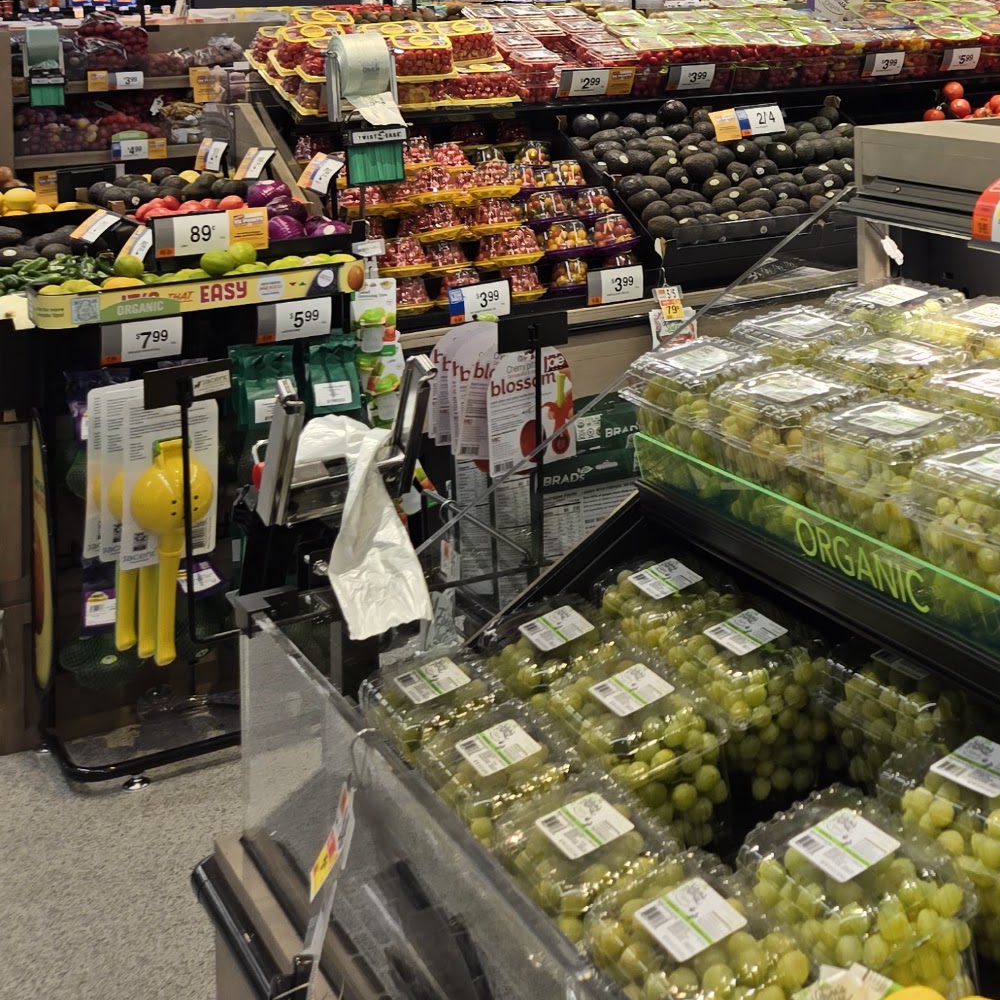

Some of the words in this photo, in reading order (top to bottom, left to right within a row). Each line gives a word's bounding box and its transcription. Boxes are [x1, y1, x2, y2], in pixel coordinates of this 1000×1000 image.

[167, 291, 193, 301] THAT
[200, 281, 248, 303] EASY
[116, 301, 165, 316] ORGANIC
[491, 371, 557, 397] blossom
[605, 424, 640, 438] BRAD
[795, 518, 931, 613] ORGANIC
